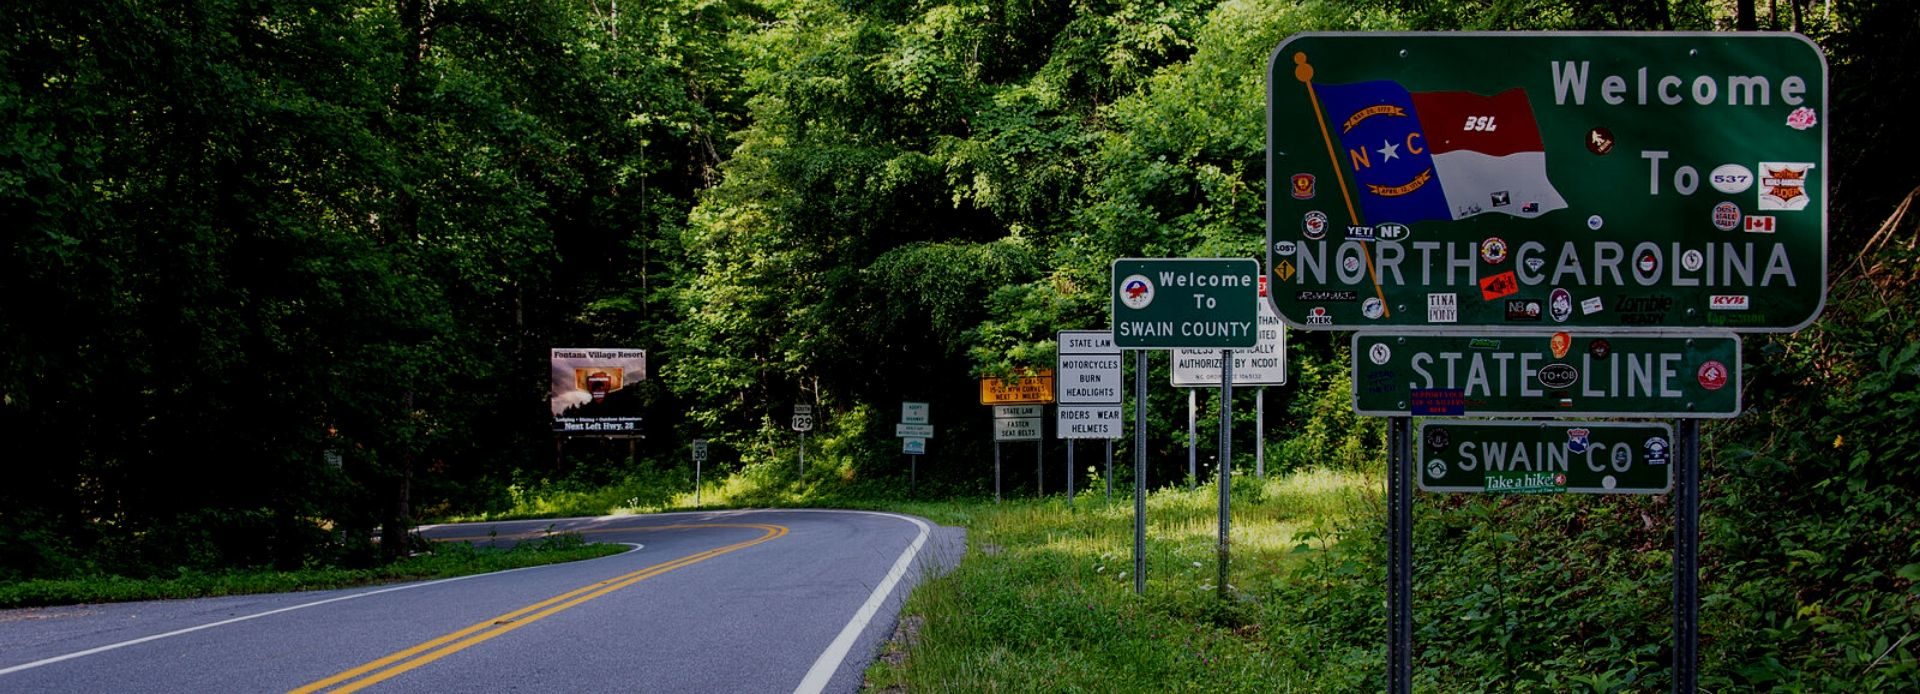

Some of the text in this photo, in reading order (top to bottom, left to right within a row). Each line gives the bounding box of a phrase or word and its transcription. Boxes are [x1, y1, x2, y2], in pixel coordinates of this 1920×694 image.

[1552, 60, 1807, 106] Welcome
[1463, 115, 1498, 132] BSL
[1350, 132, 1424, 171] N C
[1641, 150, 1700, 196] To
[1714, 175, 1748, 183] 537
[1347, 226, 1374, 236] YETI
[1380, 227, 1401, 238] NF
[1275, 244, 1295, 252] LOST
[1296, 240, 1478, 286] NORTH
[1516, 240, 1797, 287] CAROLINA
[1159, 271, 1252, 287] Welcome
[1193, 294, 1217, 310] To
[1430, 295, 1454, 305] TINA
[1119, 321, 1174, 337] SWAIN
[1181, 321, 1252, 337] COUNTY
[1069, 339, 1111, 348] STATE LAW
[588, 351, 617, 359] Village
[1062, 360, 1118, 369] MOTORCYCLES
[1179, 358, 1278, 368] AUTHORIZE BY NCDOT
[1079, 374, 1101, 383] BURN
[1410, 352, 1544, 397] STATE
[1582, 352, 1683, 398] LINE
[1066, 388, 1114, 397] HEADLIGHTS
[1060, 410, 1120, 419] RIDERS WEAR
[564, 422, 584, 430] Next
[585, 422, 602, 430] Left
[603, 422, 623, 431] Hwy.
[793, 418, 812, 428] 129
[1072, 424, 1109, 433] HELMETS
[695, 450, 706, 458] 30
[1457, 441, 1569, 472] SWAIN
[1586, 441, 1633, 472] CO
[1485, 473, 1555, 489] Take a hike!
